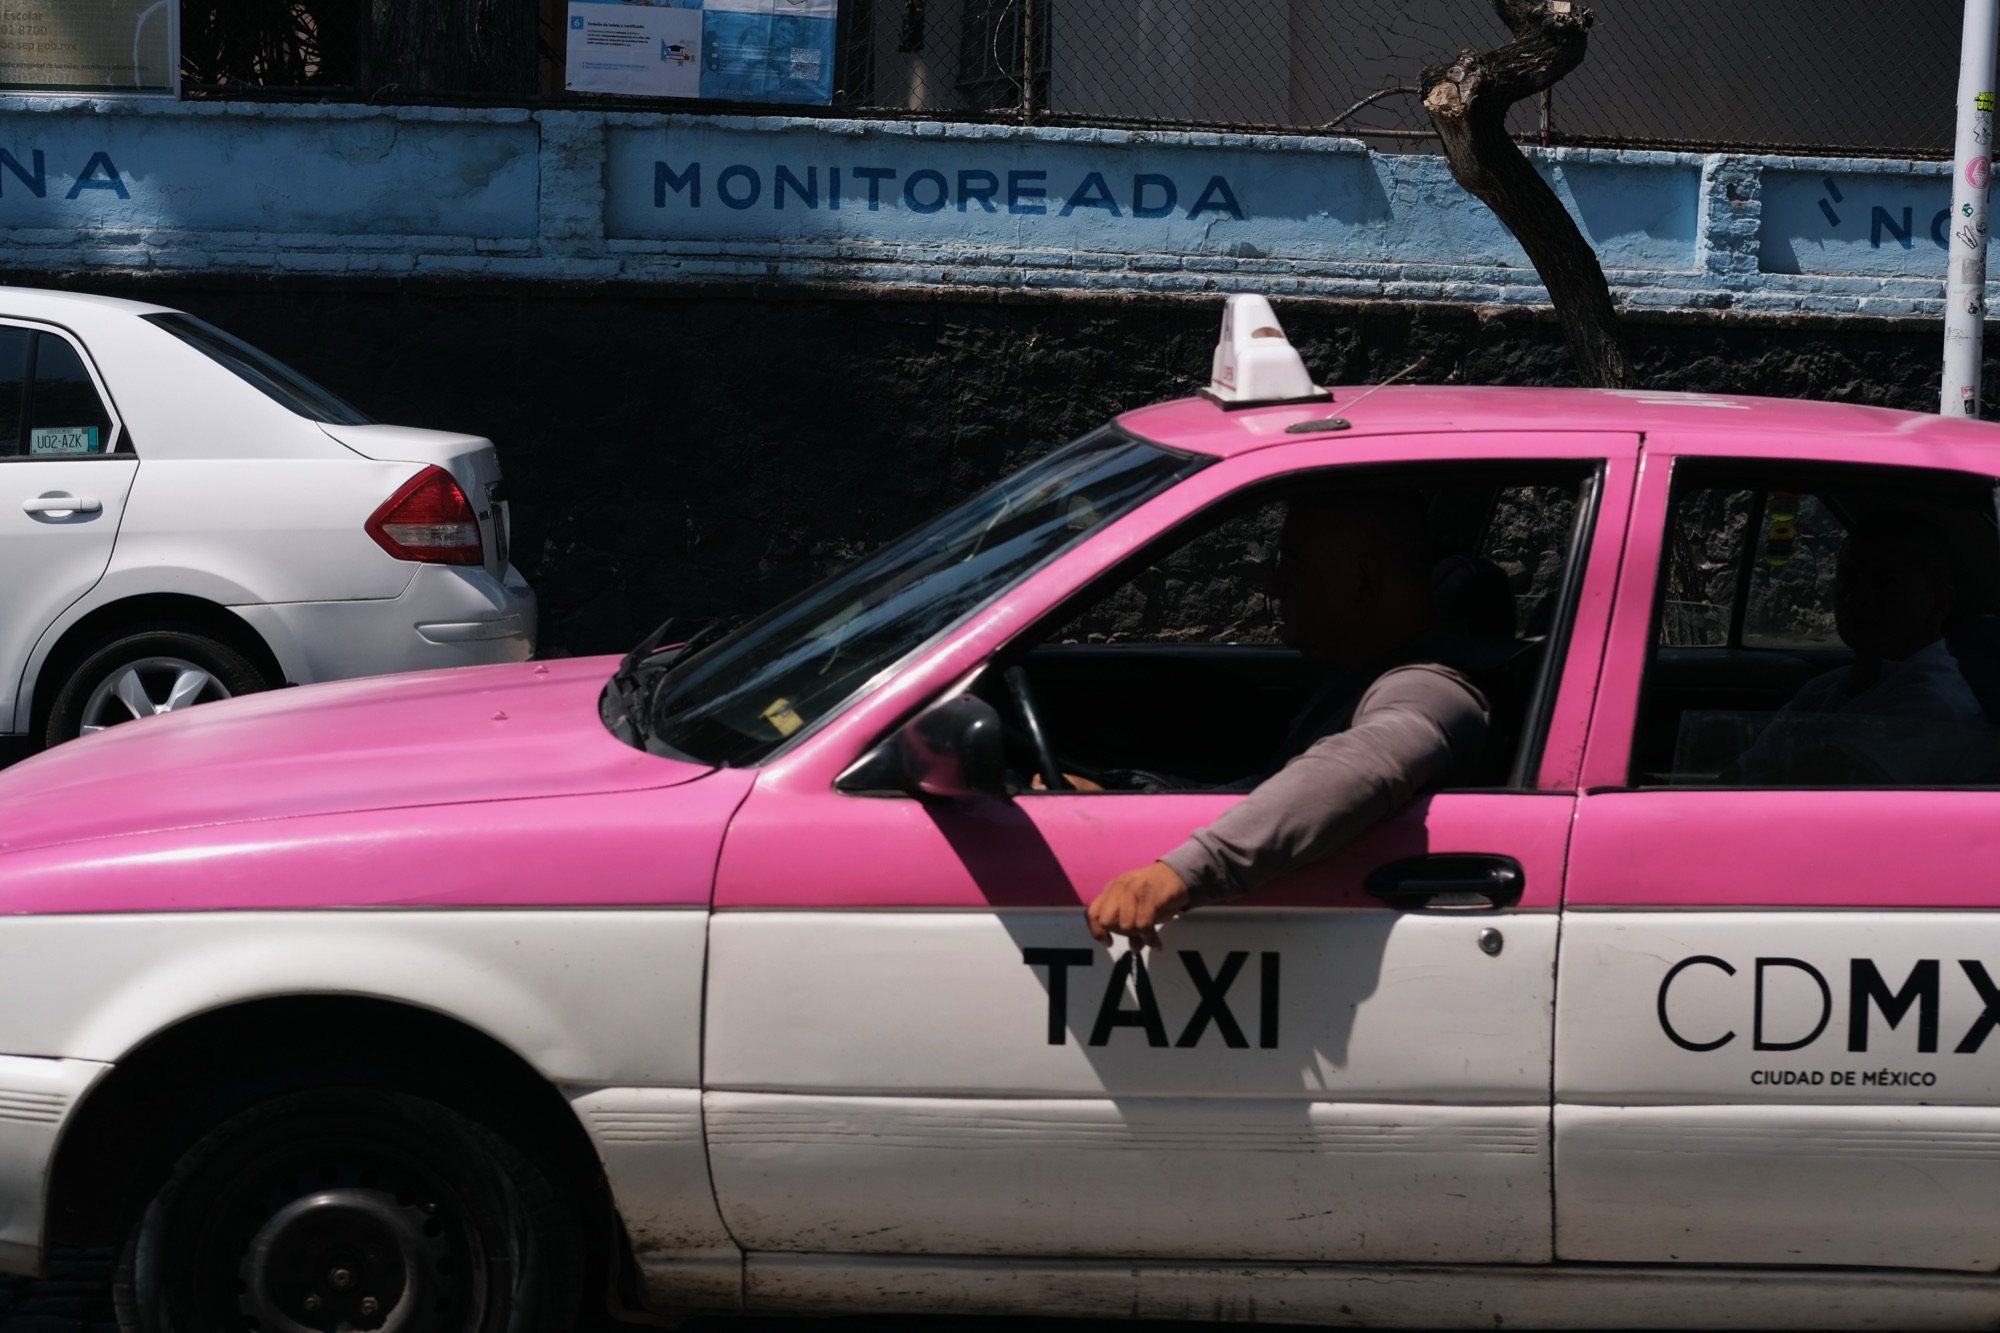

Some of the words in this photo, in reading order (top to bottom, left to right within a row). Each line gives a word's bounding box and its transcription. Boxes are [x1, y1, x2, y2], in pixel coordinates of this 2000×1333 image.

[5, 10, 43, 21] Escolar
[19, 25, 47, 35] 8700
[0, 147, 131, 200] NA
[654, 160, 1245, 221] MONITOREADA
[37, 434, 82, 449] U02-AZK
[1022, 947, 1280, 1049] TAXI
[1750, 1070, 1824, 1087] CIUDAD
[1830, 1071, 1856, 1086] DE
[1862, 1067, 1937, 1087] MÉXICO
